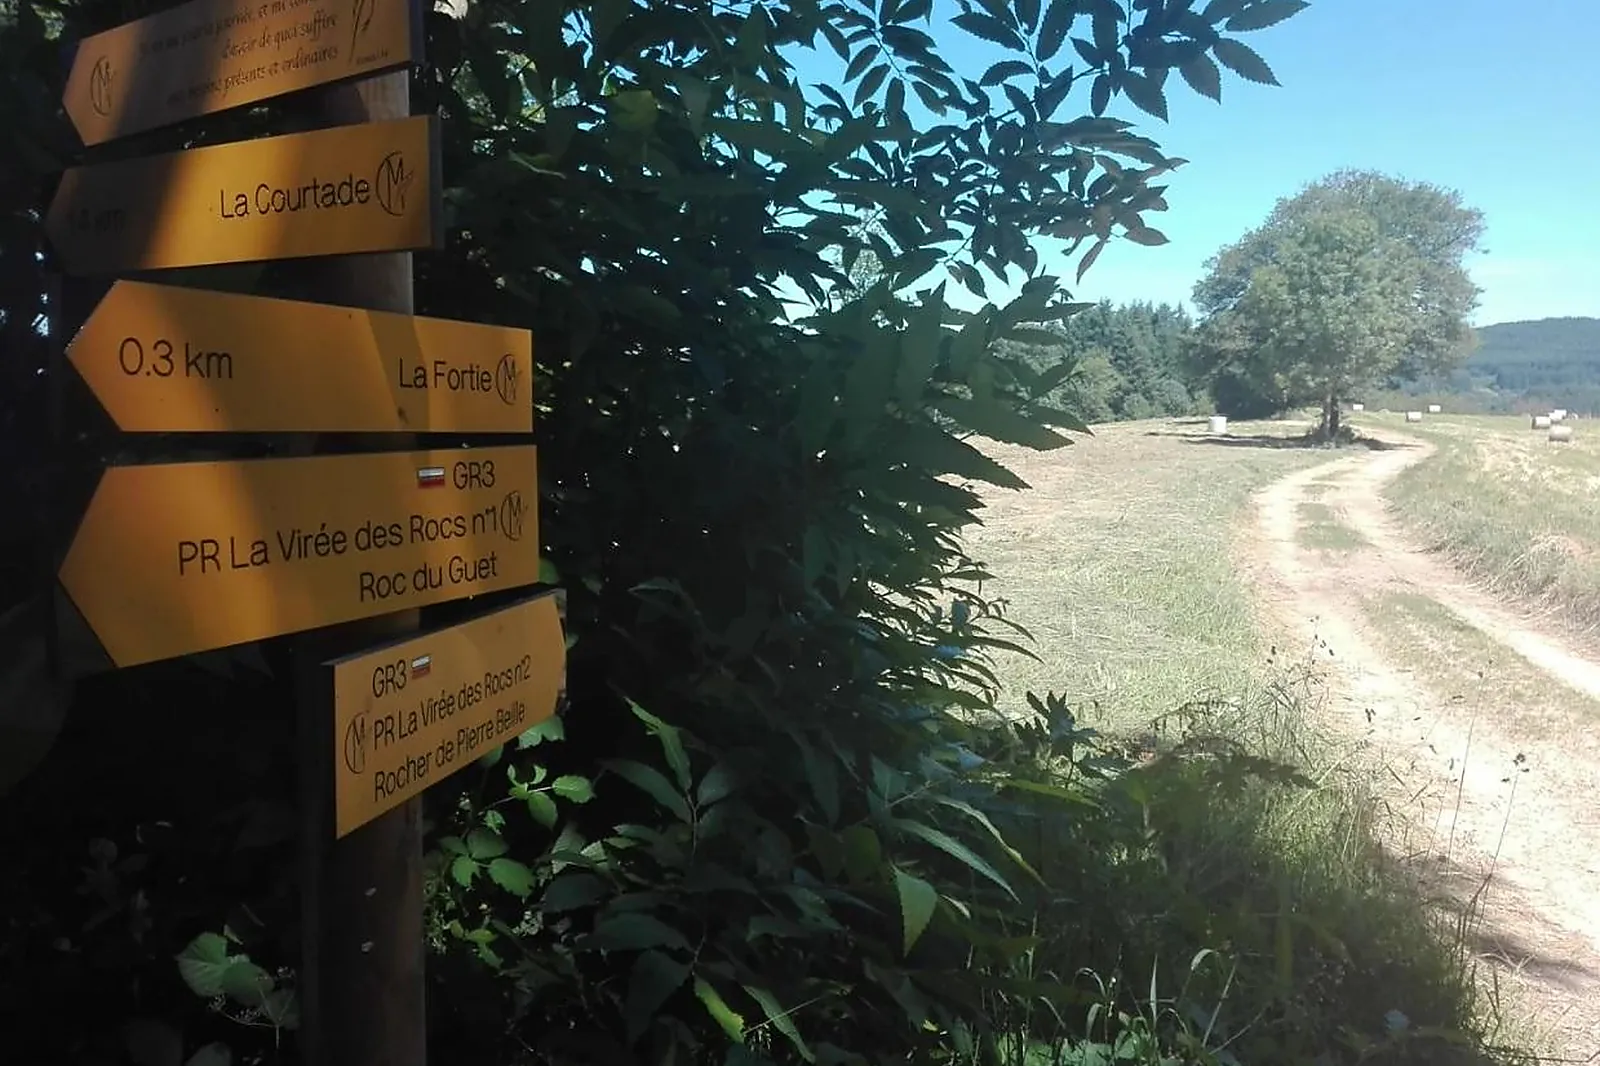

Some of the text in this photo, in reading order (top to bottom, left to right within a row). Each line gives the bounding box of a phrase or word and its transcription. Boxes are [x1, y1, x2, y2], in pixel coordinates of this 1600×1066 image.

[282, 46, 338, 71] ordinaires
[220, 173, 370, 218] La Courtade
[119, 337, 232, 378] 0.3 km
[399, 358, 493, 392] La Fortie
[452, 460, 496, 490] GR3
[178, 539, 221, 576] PR
[230, 536, 270, 569] La
[277, 523, 348, 562] Virée
[355, 520, 404, 551] des
[410, 515, 467, 543] Rocs
[359, 551, 497, 602] Roc du Guet
[372, 659, 407, 698] GR3
[374, 714, 395, 750] PR
[398, 710, 418, 740] La
[420, 688, 455, 727] Virée
[457, 682, 482, 710] des
[484, 672, 513, 698] Rocs
[374, 700, 525, 802] Rocher de Pierre Beille
